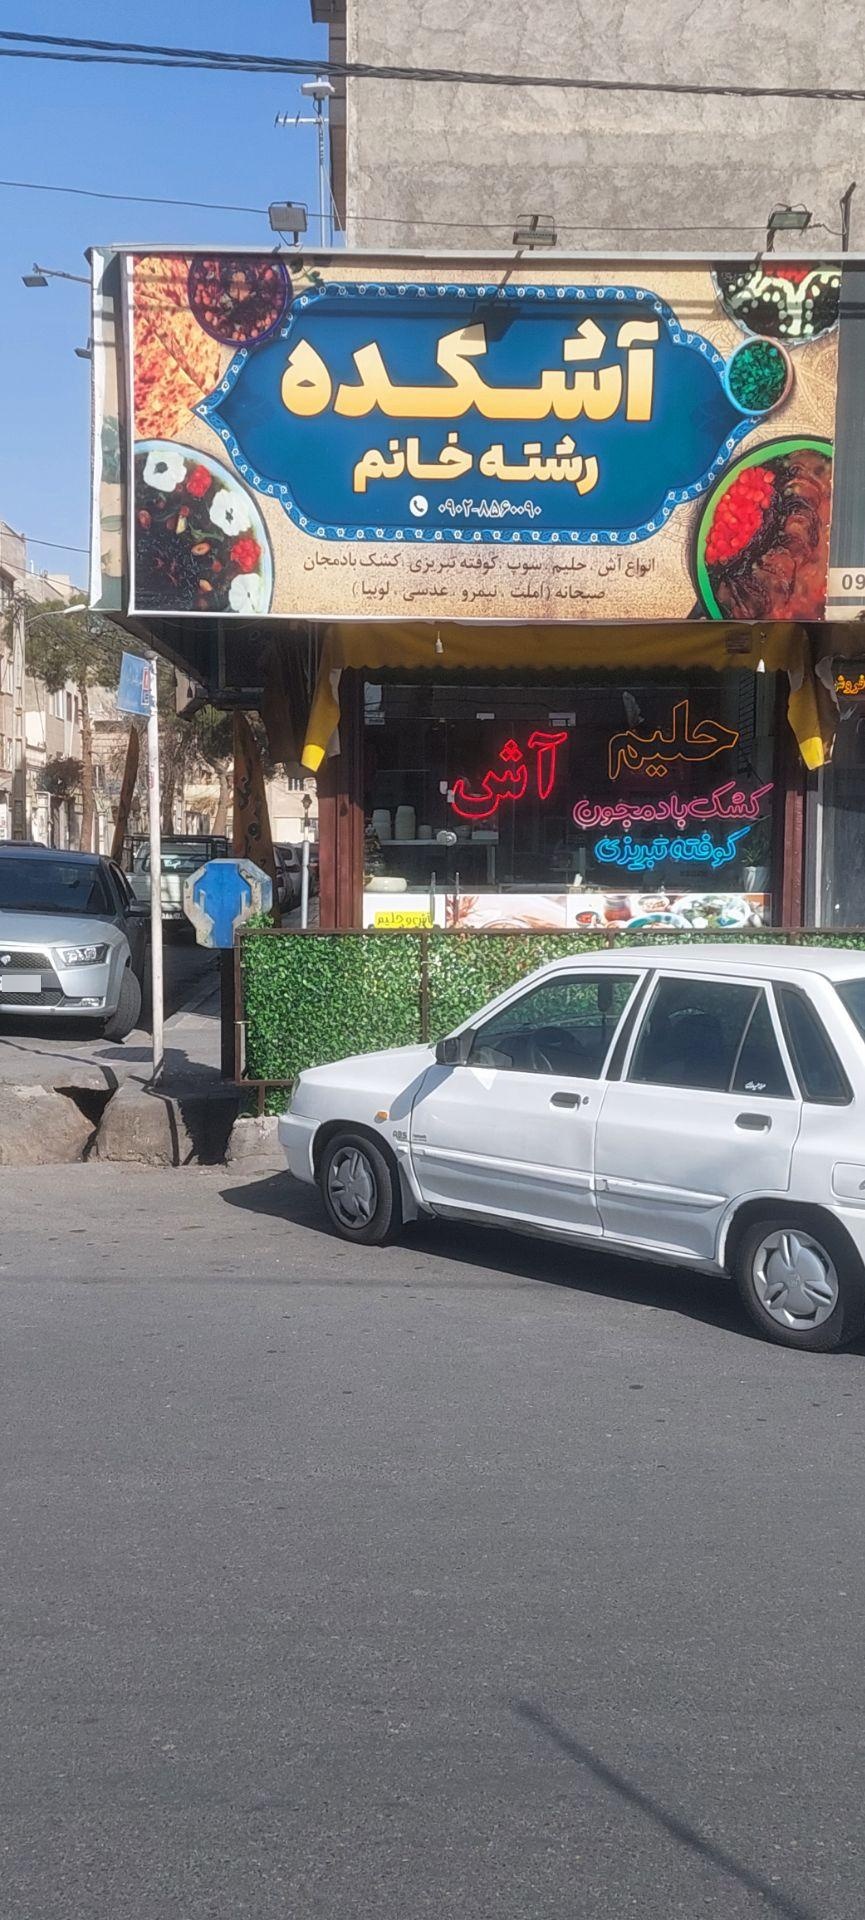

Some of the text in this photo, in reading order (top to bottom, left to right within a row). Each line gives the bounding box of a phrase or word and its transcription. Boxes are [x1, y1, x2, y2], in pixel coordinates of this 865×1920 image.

[280, 317, 660, 422] آشکده
[352, 431, 600, 496] رشته خانم
[438, 498, 542, 519] ۰۹۰۲-۸۵۶۰۰۹۰
[303, 551, 357, 572] بادمجان
[360, 552, 402, 568] کشک
[459, 555, 499, 575] کوفته
[624, 556, 656, 578] انواع
[554, 582, 606, 604] صبحانه
[608, 699, 740, 780] حلیم
[451, 731, 568, 819] آش
[573, 780, 774, 829] کشک بادمجون
[594, 826, 752, 871] کوفته تبریزی
